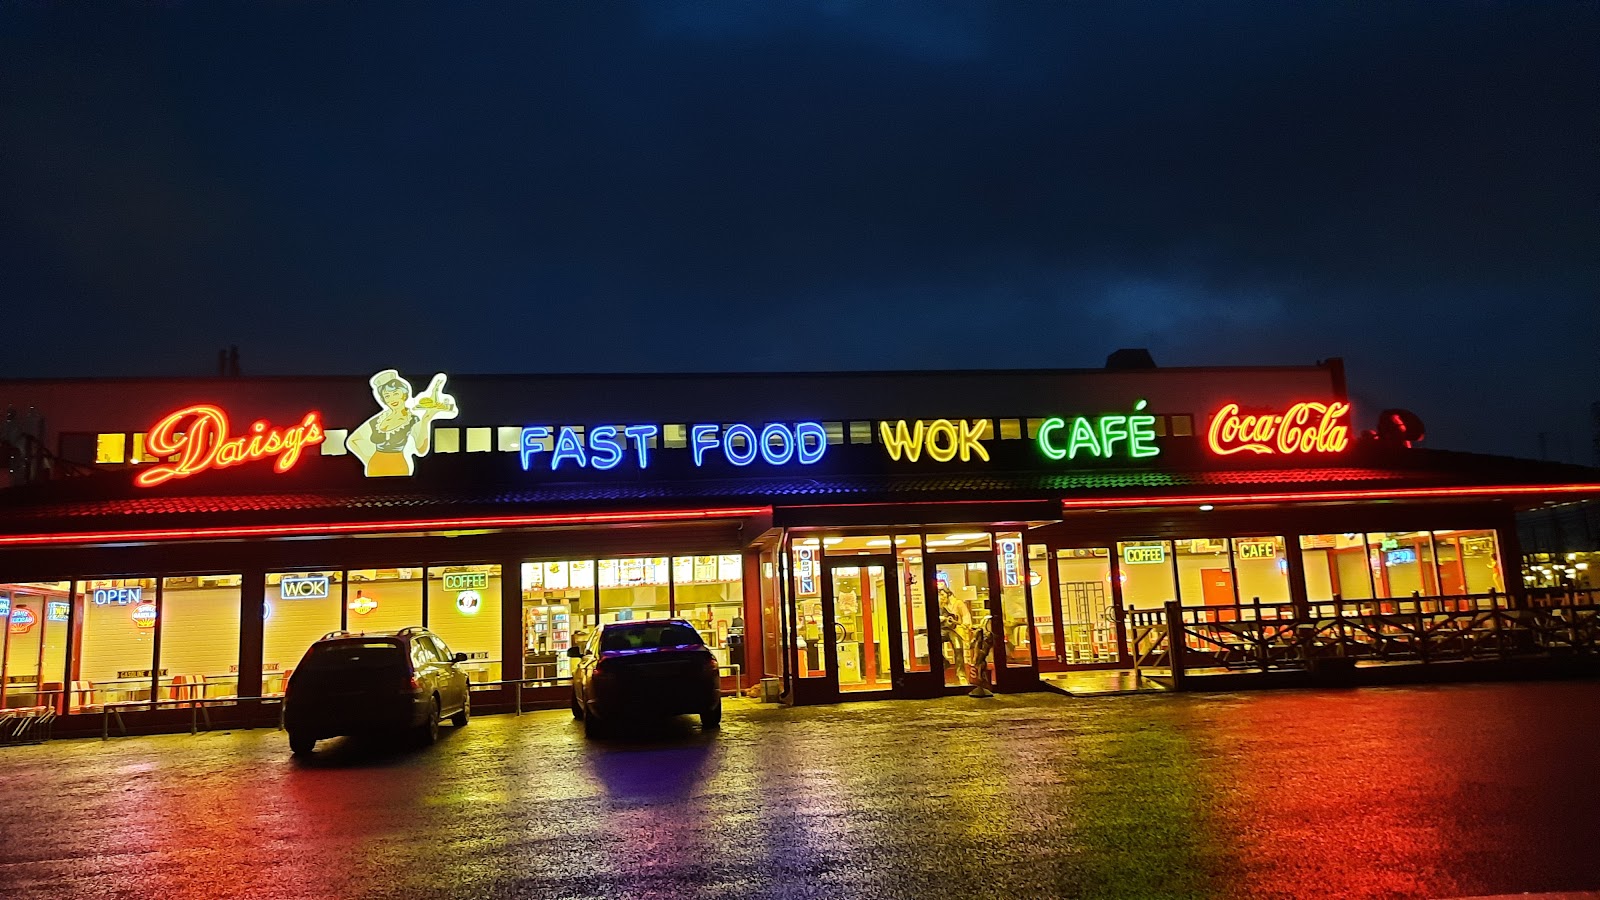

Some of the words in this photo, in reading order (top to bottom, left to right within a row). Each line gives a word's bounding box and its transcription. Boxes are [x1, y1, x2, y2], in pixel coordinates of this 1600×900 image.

[138, 405, 322, 485] Daisy's
[519, 425, 657, 471] FAST
[691, 421, 827, 467] FOOD
[880, 418, 990, 462] WOK
[1038, 399, 1160, 460] CAFÉ
[1208, 401, 1350, 455] Coca-Cola
[1126, 550, 1163, 562] COFFEE
[95, 588, 140, 605] OPEN
[284, 581, 325, 597] WOK
[446, 574, 485, 589] COFFEE
